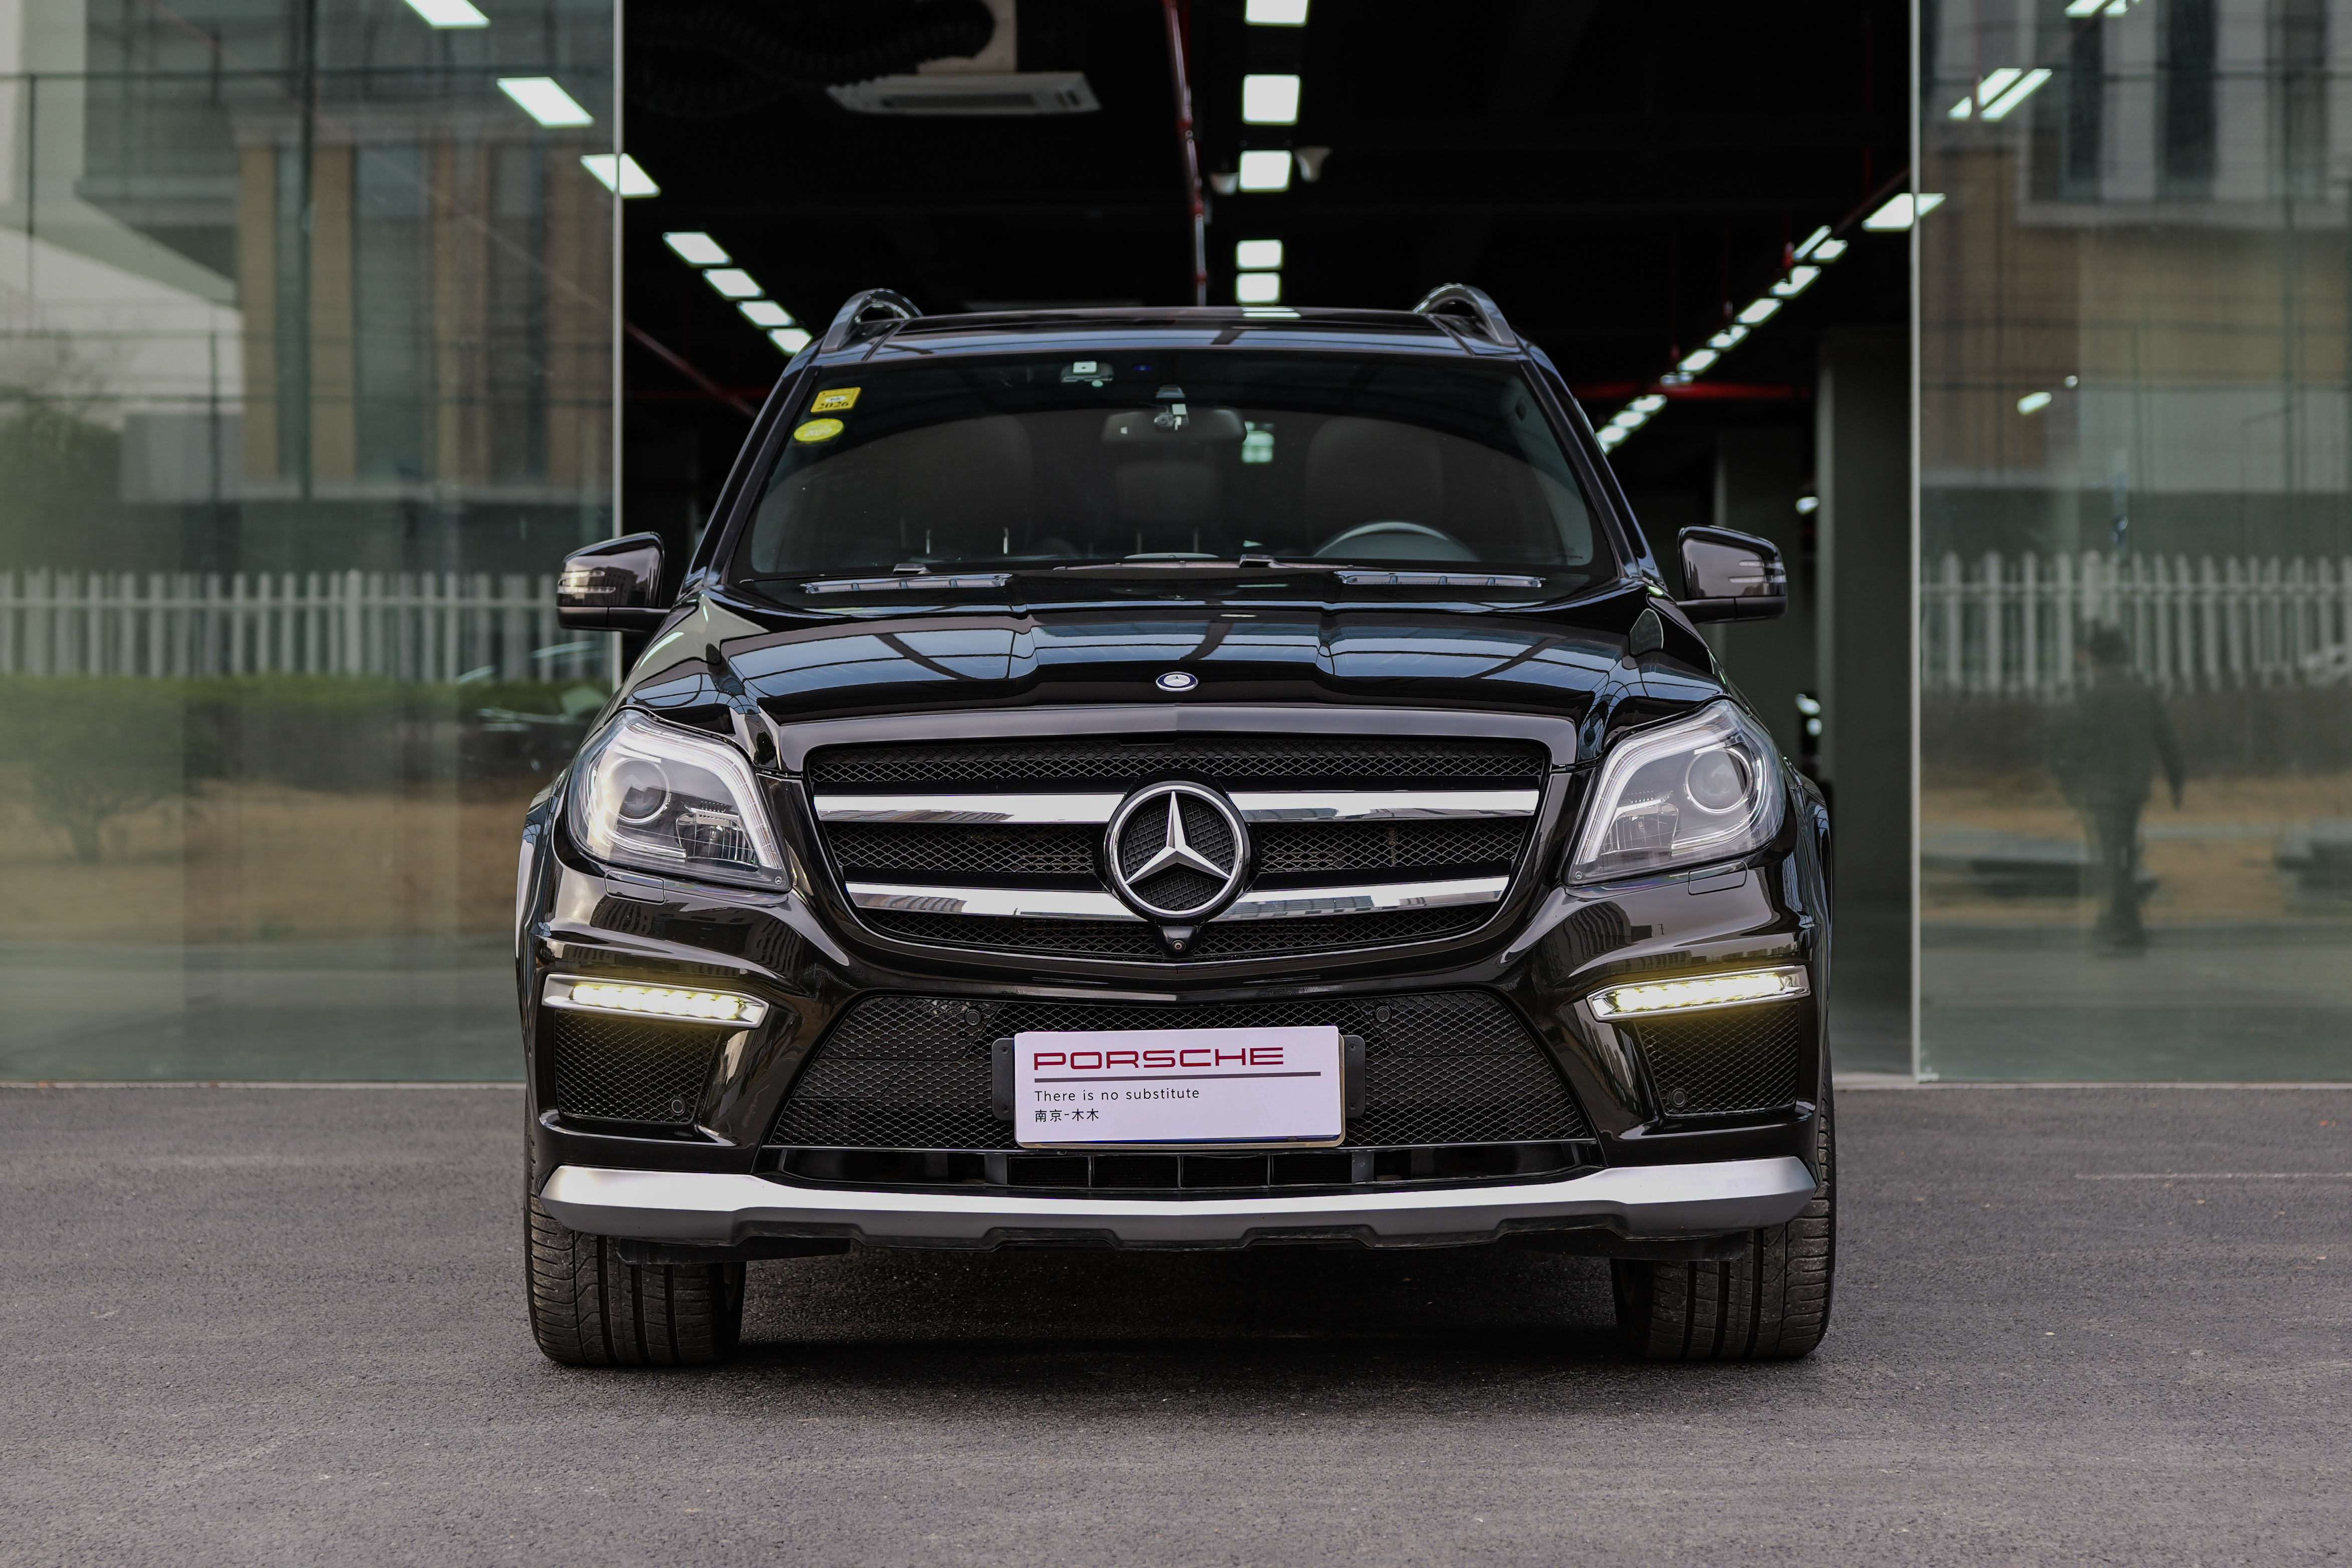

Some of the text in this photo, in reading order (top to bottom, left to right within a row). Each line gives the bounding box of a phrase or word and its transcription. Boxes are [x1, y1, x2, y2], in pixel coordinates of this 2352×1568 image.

[817, 402, 849, 410] 2026
[1034, 1047, 1284, 1071] PORSCHE
[1034, 1088, 1200, 1102] There is no substitute
[1035, 1108, 1099, 1122] 南京-木木
